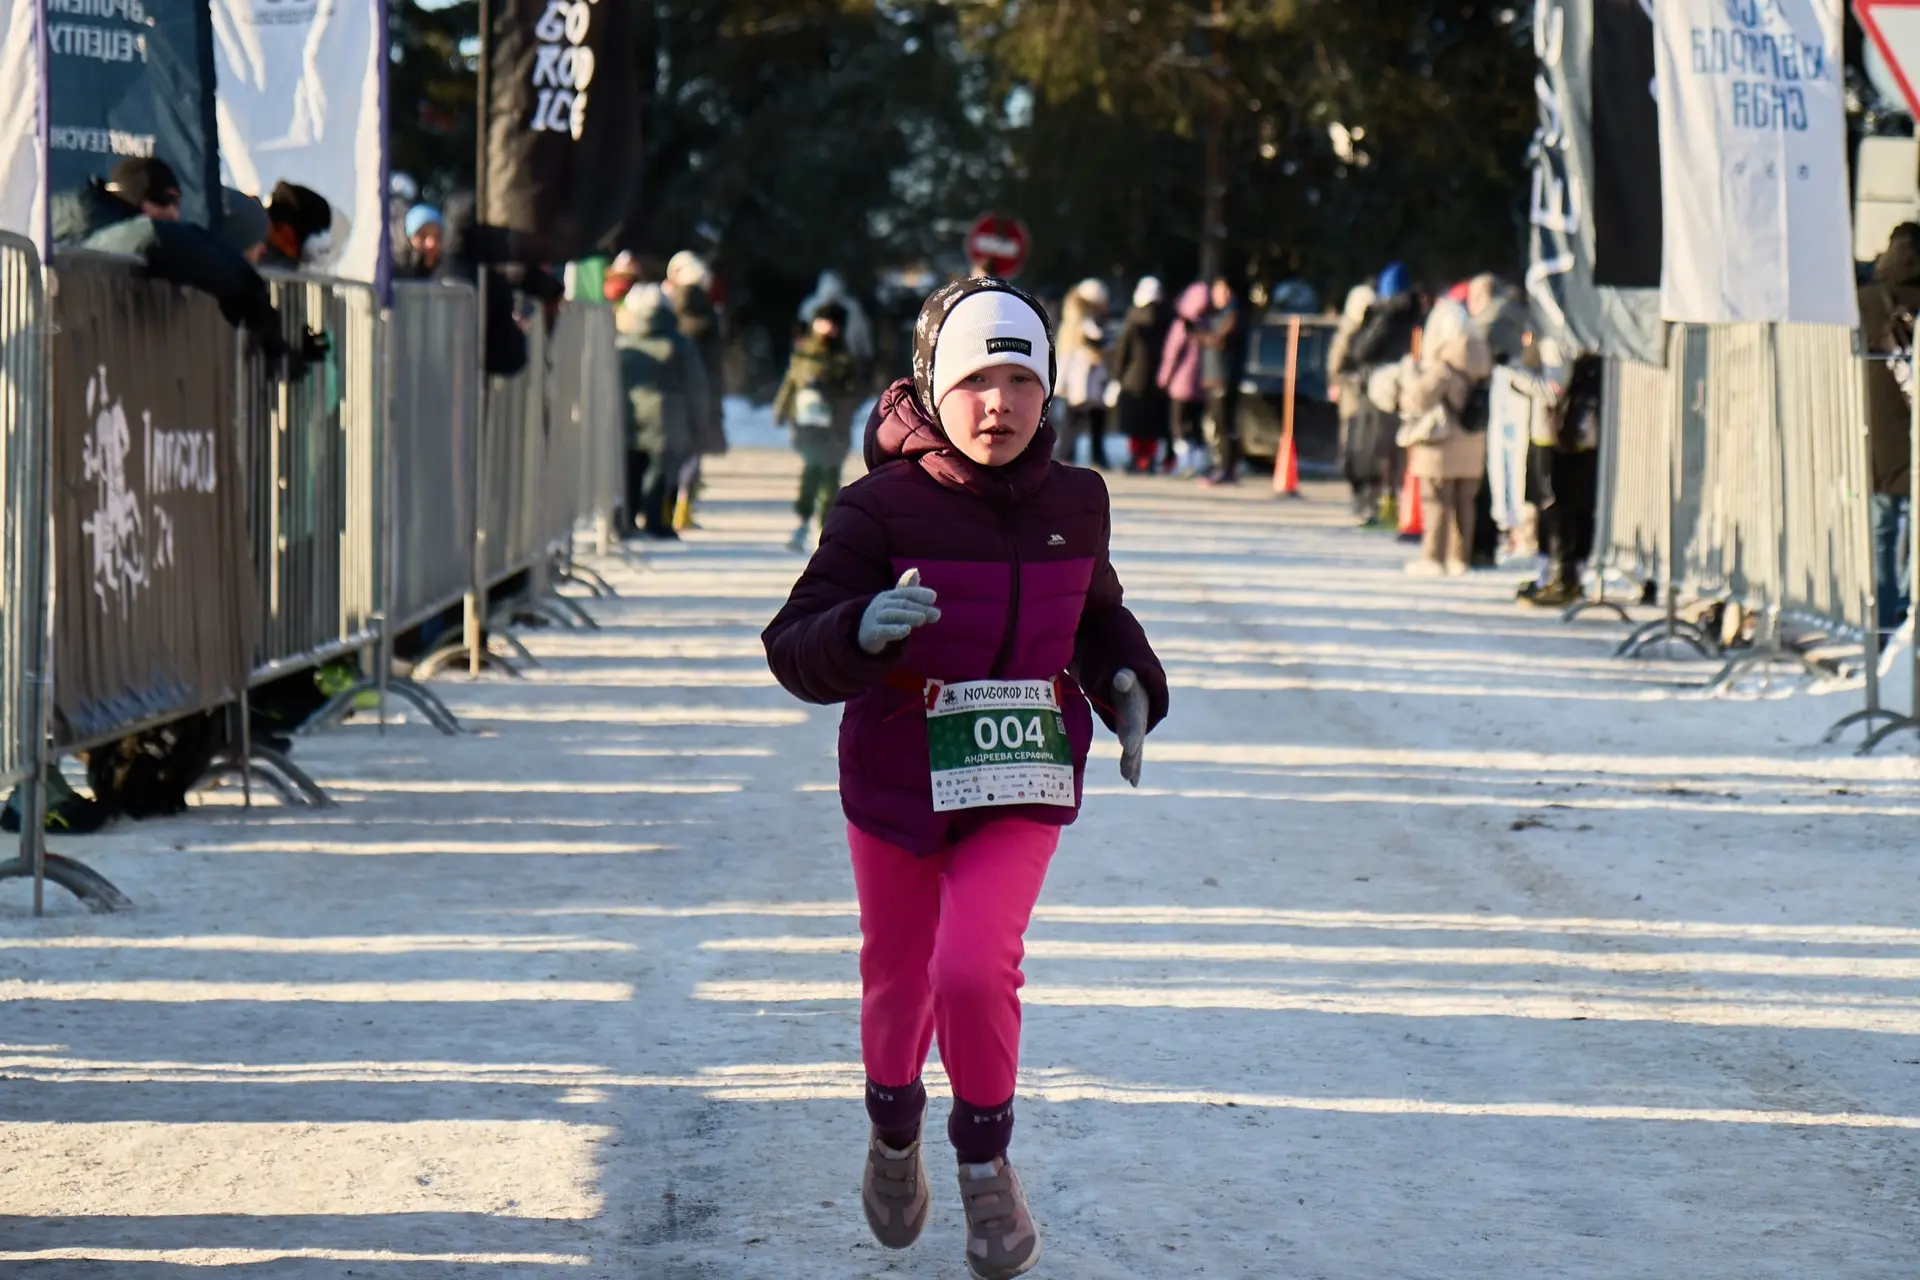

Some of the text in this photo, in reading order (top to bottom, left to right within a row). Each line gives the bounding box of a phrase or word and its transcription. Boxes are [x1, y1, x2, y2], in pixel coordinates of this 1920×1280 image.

[964, 686, 1040, 702] NOVGOROD ICE
[974, 716, 1045, 750] 004
[964, 754, 1013, 764] АНДРЕЕВА
